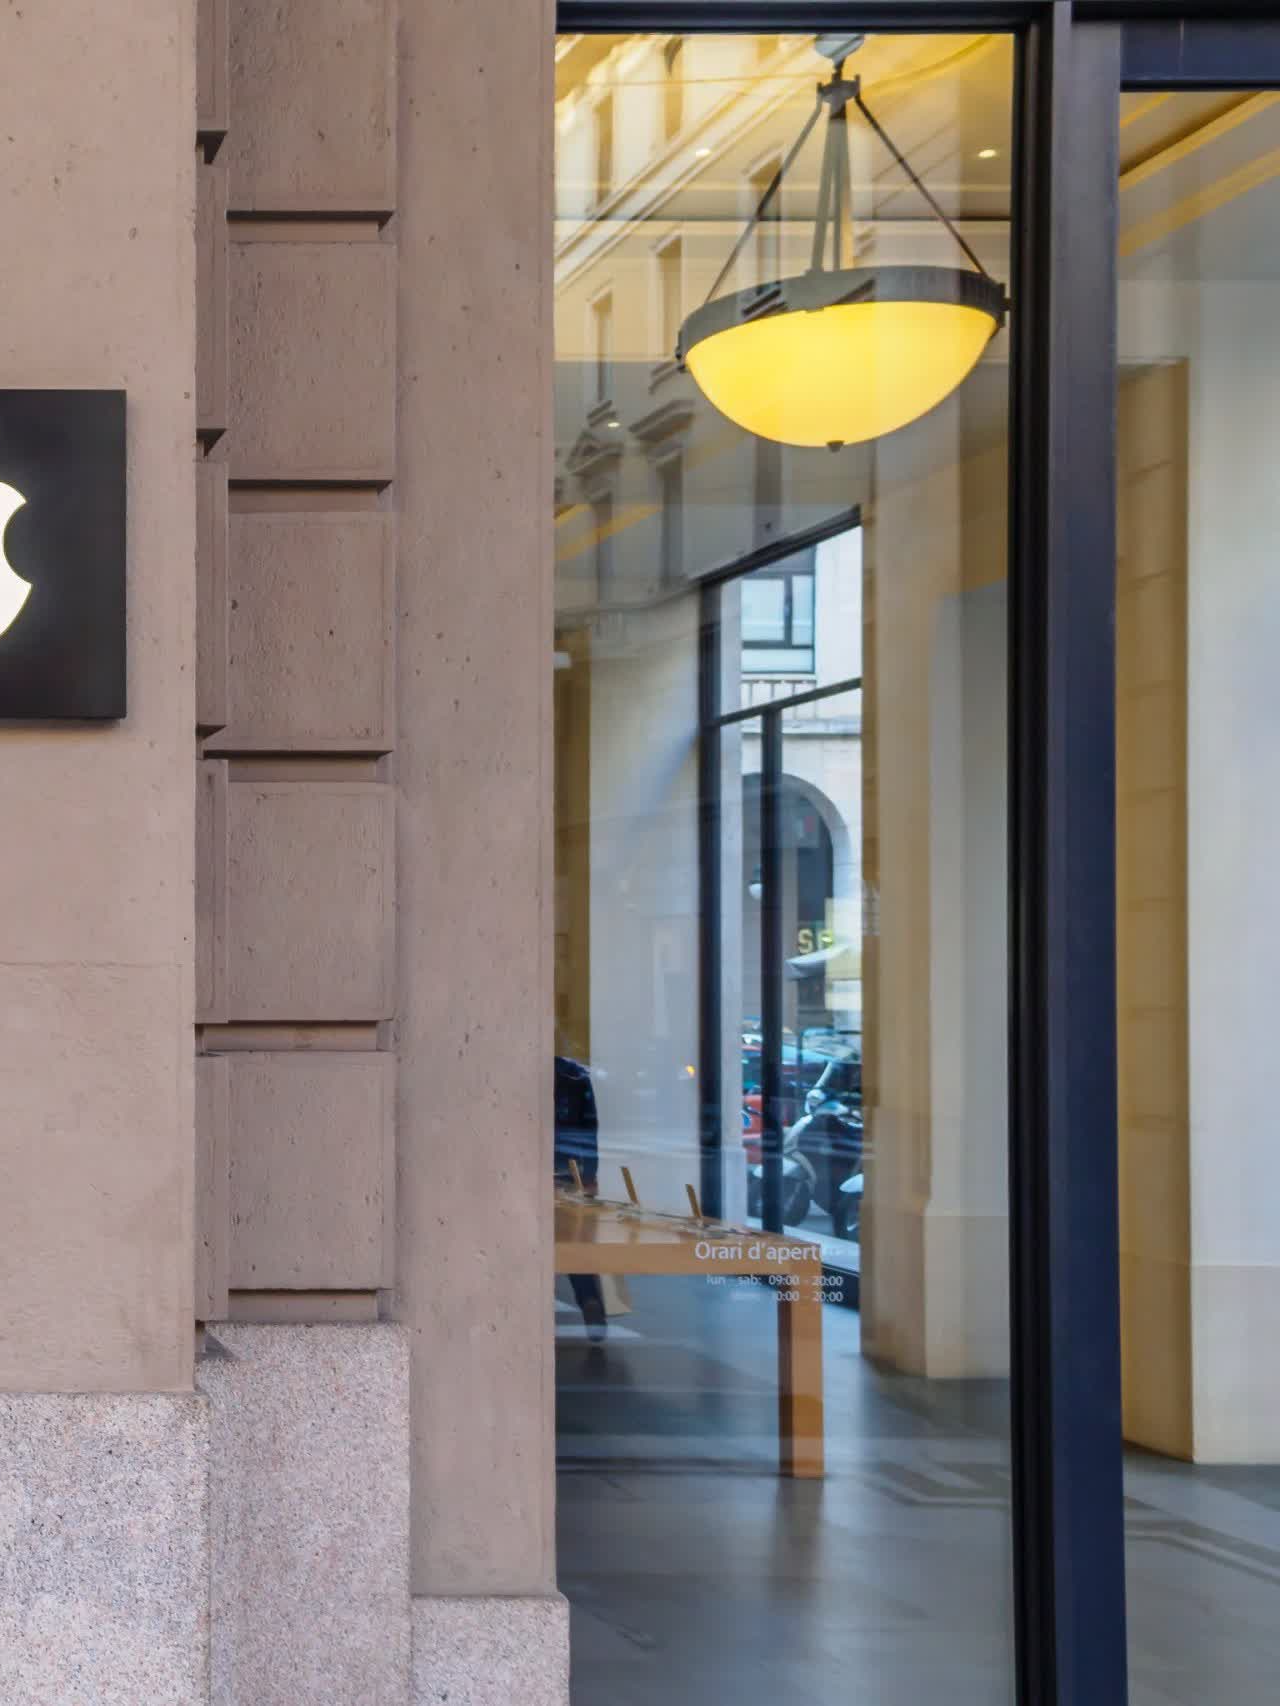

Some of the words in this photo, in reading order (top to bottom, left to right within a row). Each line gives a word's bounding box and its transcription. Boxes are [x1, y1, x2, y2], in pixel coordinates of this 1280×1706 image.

[695, 1241, 742, 1260] Orari
[768, 1275, 800, 1287] 09:00
[812, 1275, 844, 1287] 20:00
[771, 1291, 800, 1302] 0:00
